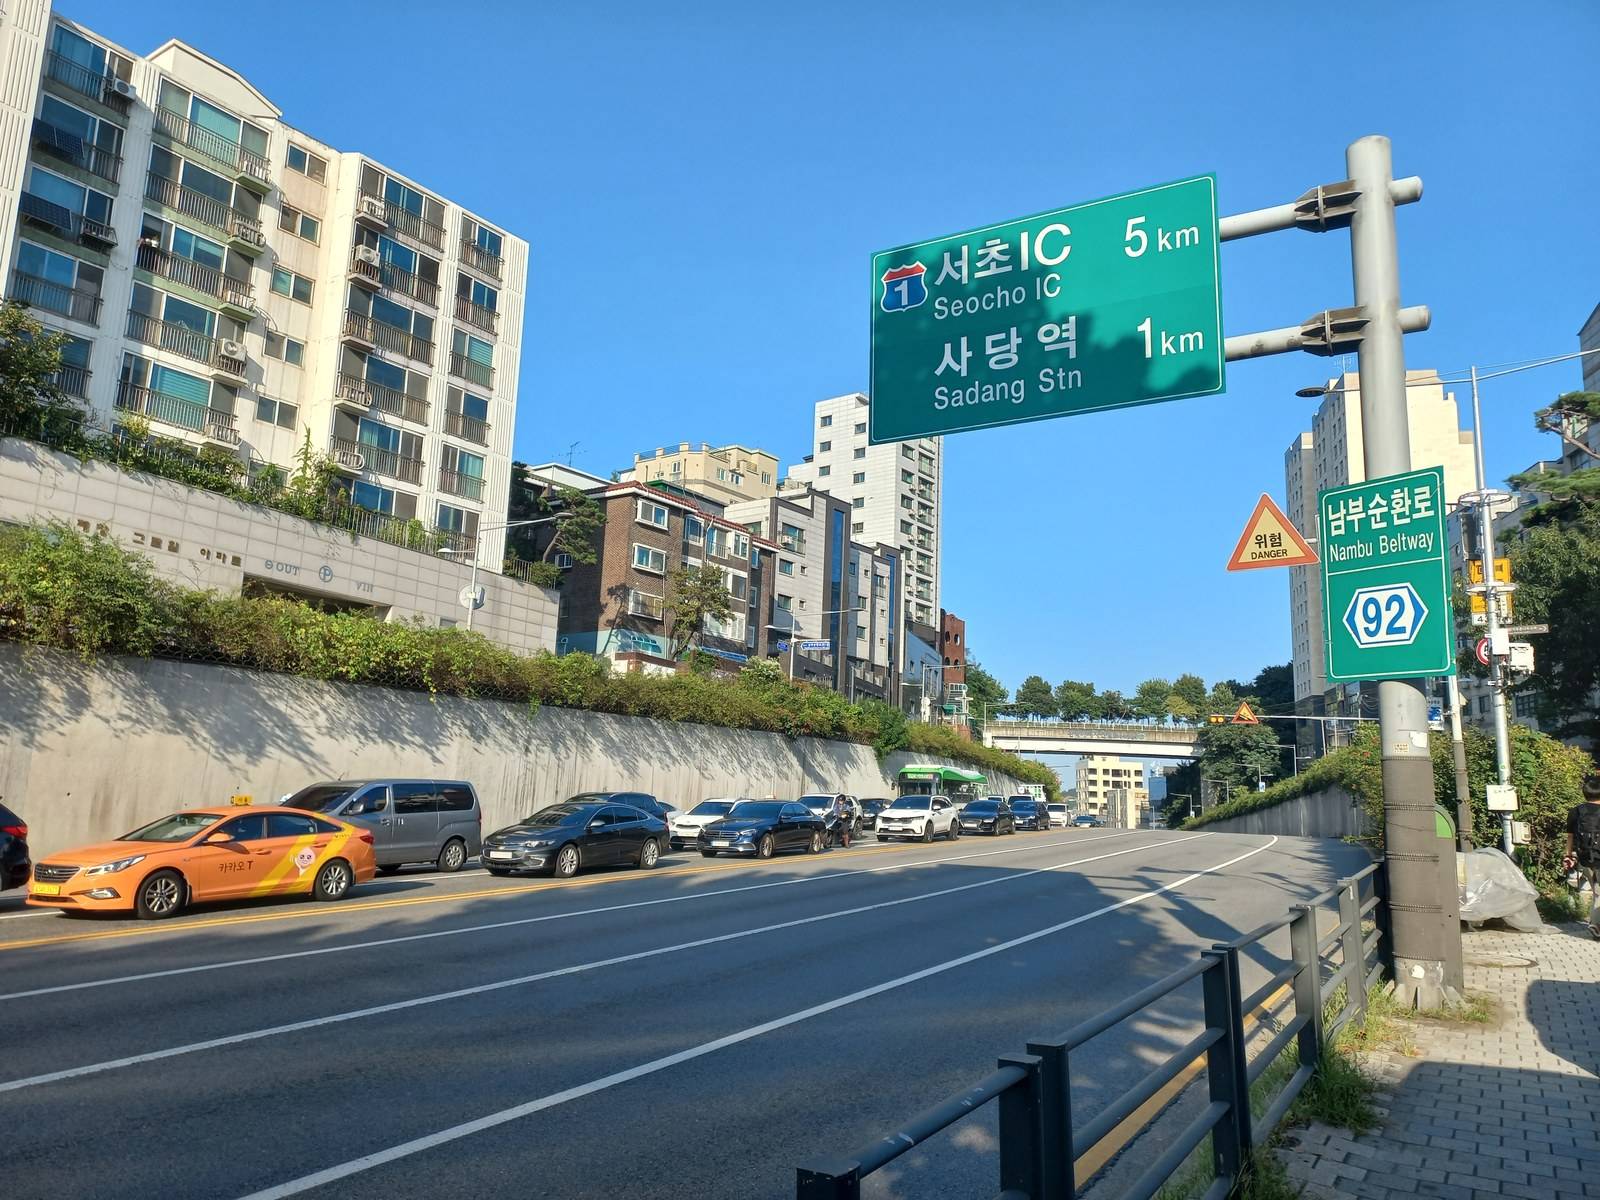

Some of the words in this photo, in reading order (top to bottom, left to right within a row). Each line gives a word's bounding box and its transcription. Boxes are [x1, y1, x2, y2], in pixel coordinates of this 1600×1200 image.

[933, 223, 1072, 286] 서초IC
[1124, 215, 1149, 258] 5
[1157, 225, 1200, 252] km
[894, 282, 908, 306] 1
[933, 286, 1026, 320] Seocho
[1035, 273, 1062, 300] IC
[934, 316, 1077, 378] 사당역
[934, 377, 1025, 410] Sadang
[1038, 367, 1082, 394] Stn
[1327, 485, 1435, 537] 남부순환로
[1251, 548, 1288, 560] DANGER
[1254, 532, 1282, 549] 위험
[1329, 541, 1373, 562] Nambu
[1379, 531, 1434, 555] Beltway
[200, 548, 242, 567] 아파트
[276, 562, 300, 576] OUT
[1362, 593, 1407, 638] 92
[218, 861, 245, 873] 카카오
[247, 860, 254, 870] T
